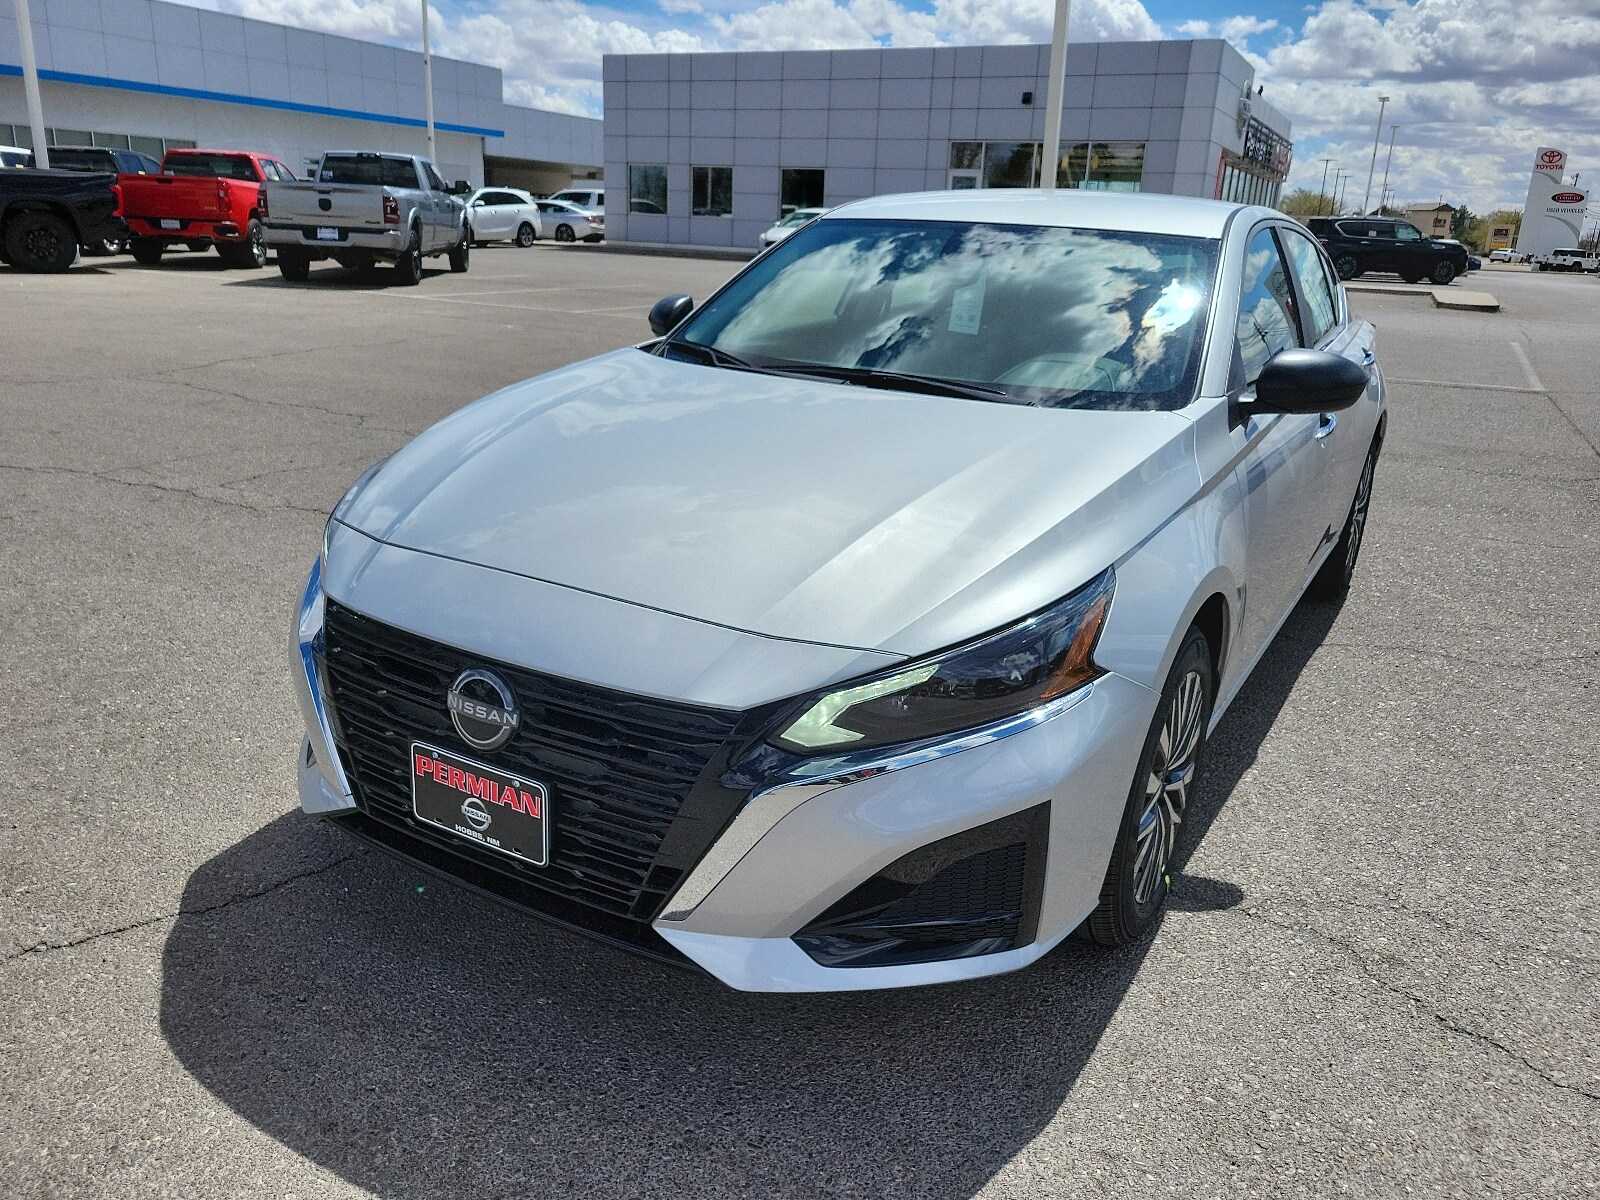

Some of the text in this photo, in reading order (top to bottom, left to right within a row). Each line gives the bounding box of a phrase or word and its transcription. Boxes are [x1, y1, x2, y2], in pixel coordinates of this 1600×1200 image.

[448, 693, 517, 725] NISSAN
[415, 754, 541, 819] PERMIAN
[464, 807, 490, 822] NISSAN
[455, 823, 500, 847] HOBBS, NM
